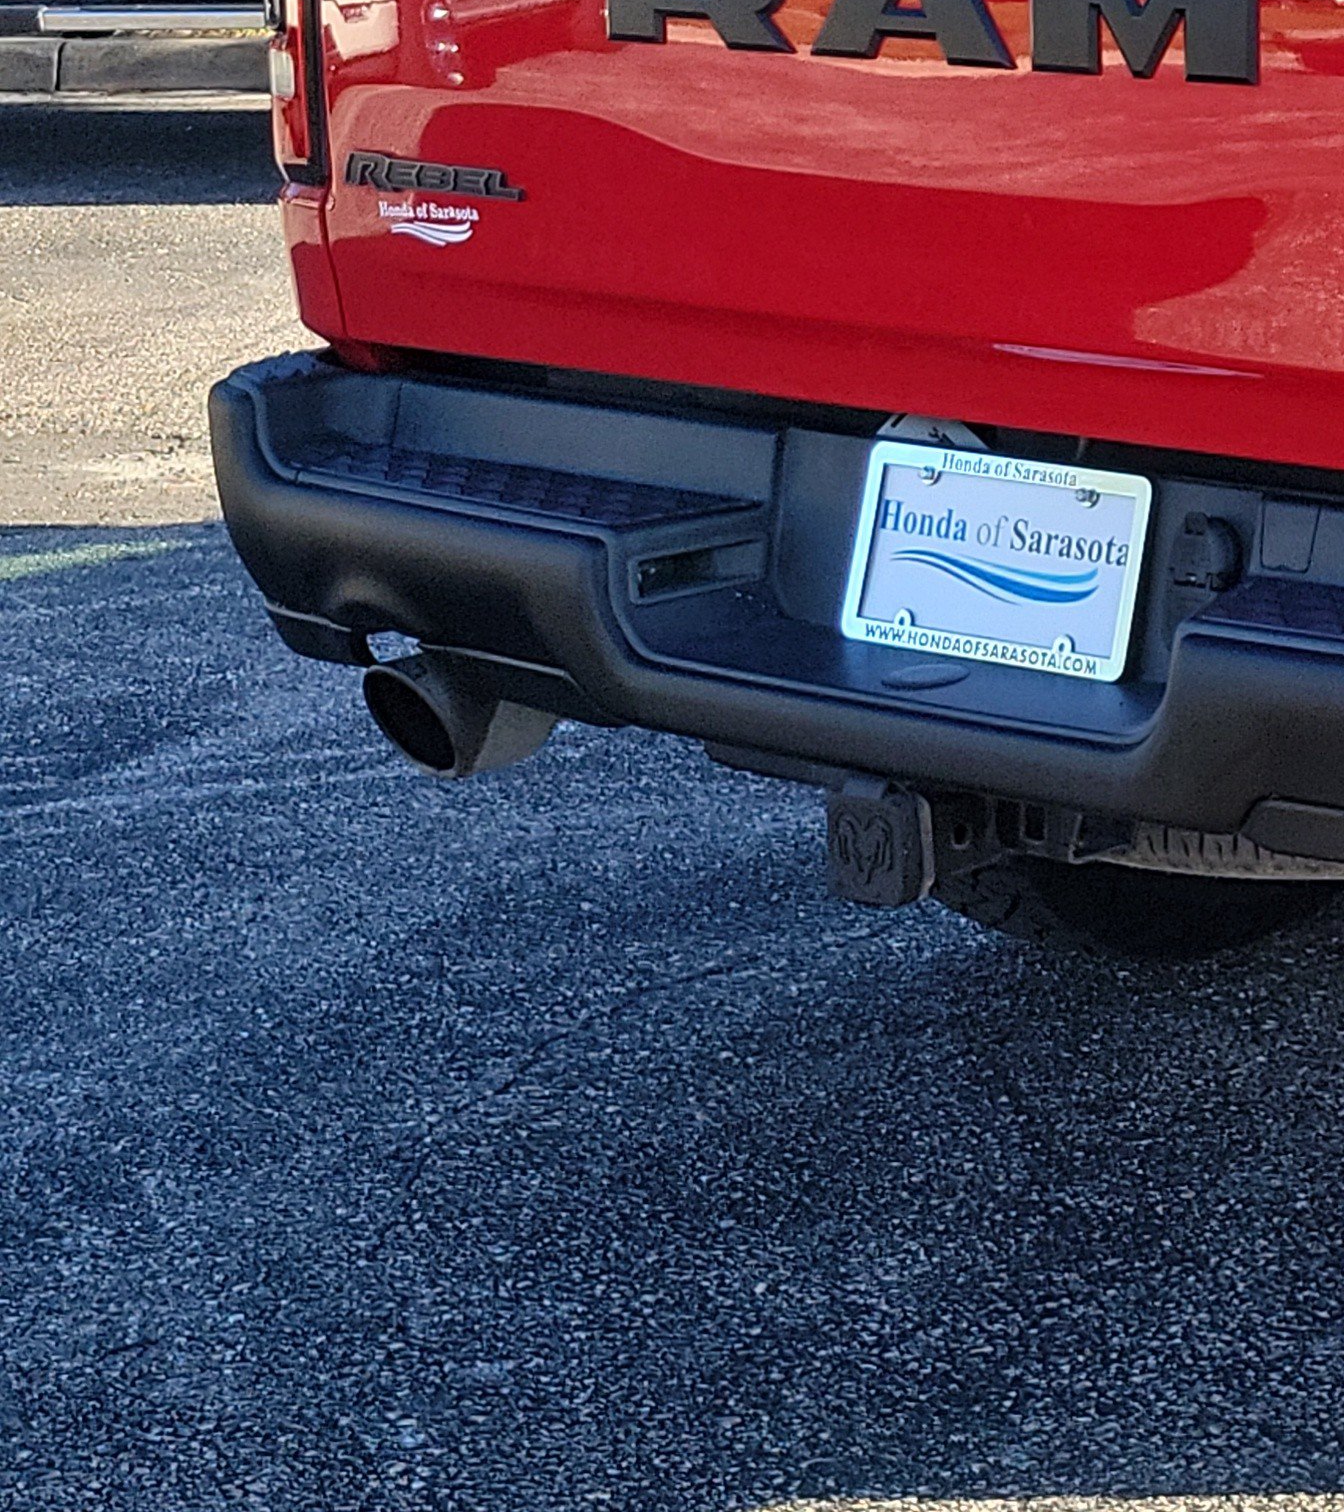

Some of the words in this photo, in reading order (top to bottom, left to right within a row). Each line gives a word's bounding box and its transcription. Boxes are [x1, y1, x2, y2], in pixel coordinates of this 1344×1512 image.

[346, 148, 526, 202] REBEL
[378, 200, 415, 218] Honda
[416, 201, 428, 219] of
[428, 202, 479, 221] Sarasota
[942, 452, 990, 476] Honda
[994, 460, 1013, 479] of
[1013, 462, 1078, 487] Sarasota
[880, 498, 968, 543] Honda
[976, 515, 1009, 547] of
[1009, 517, 1130, 568] Sarasota
[864, 622, 1098, 676] WWW.HONDAOFSARASOTA.COM
